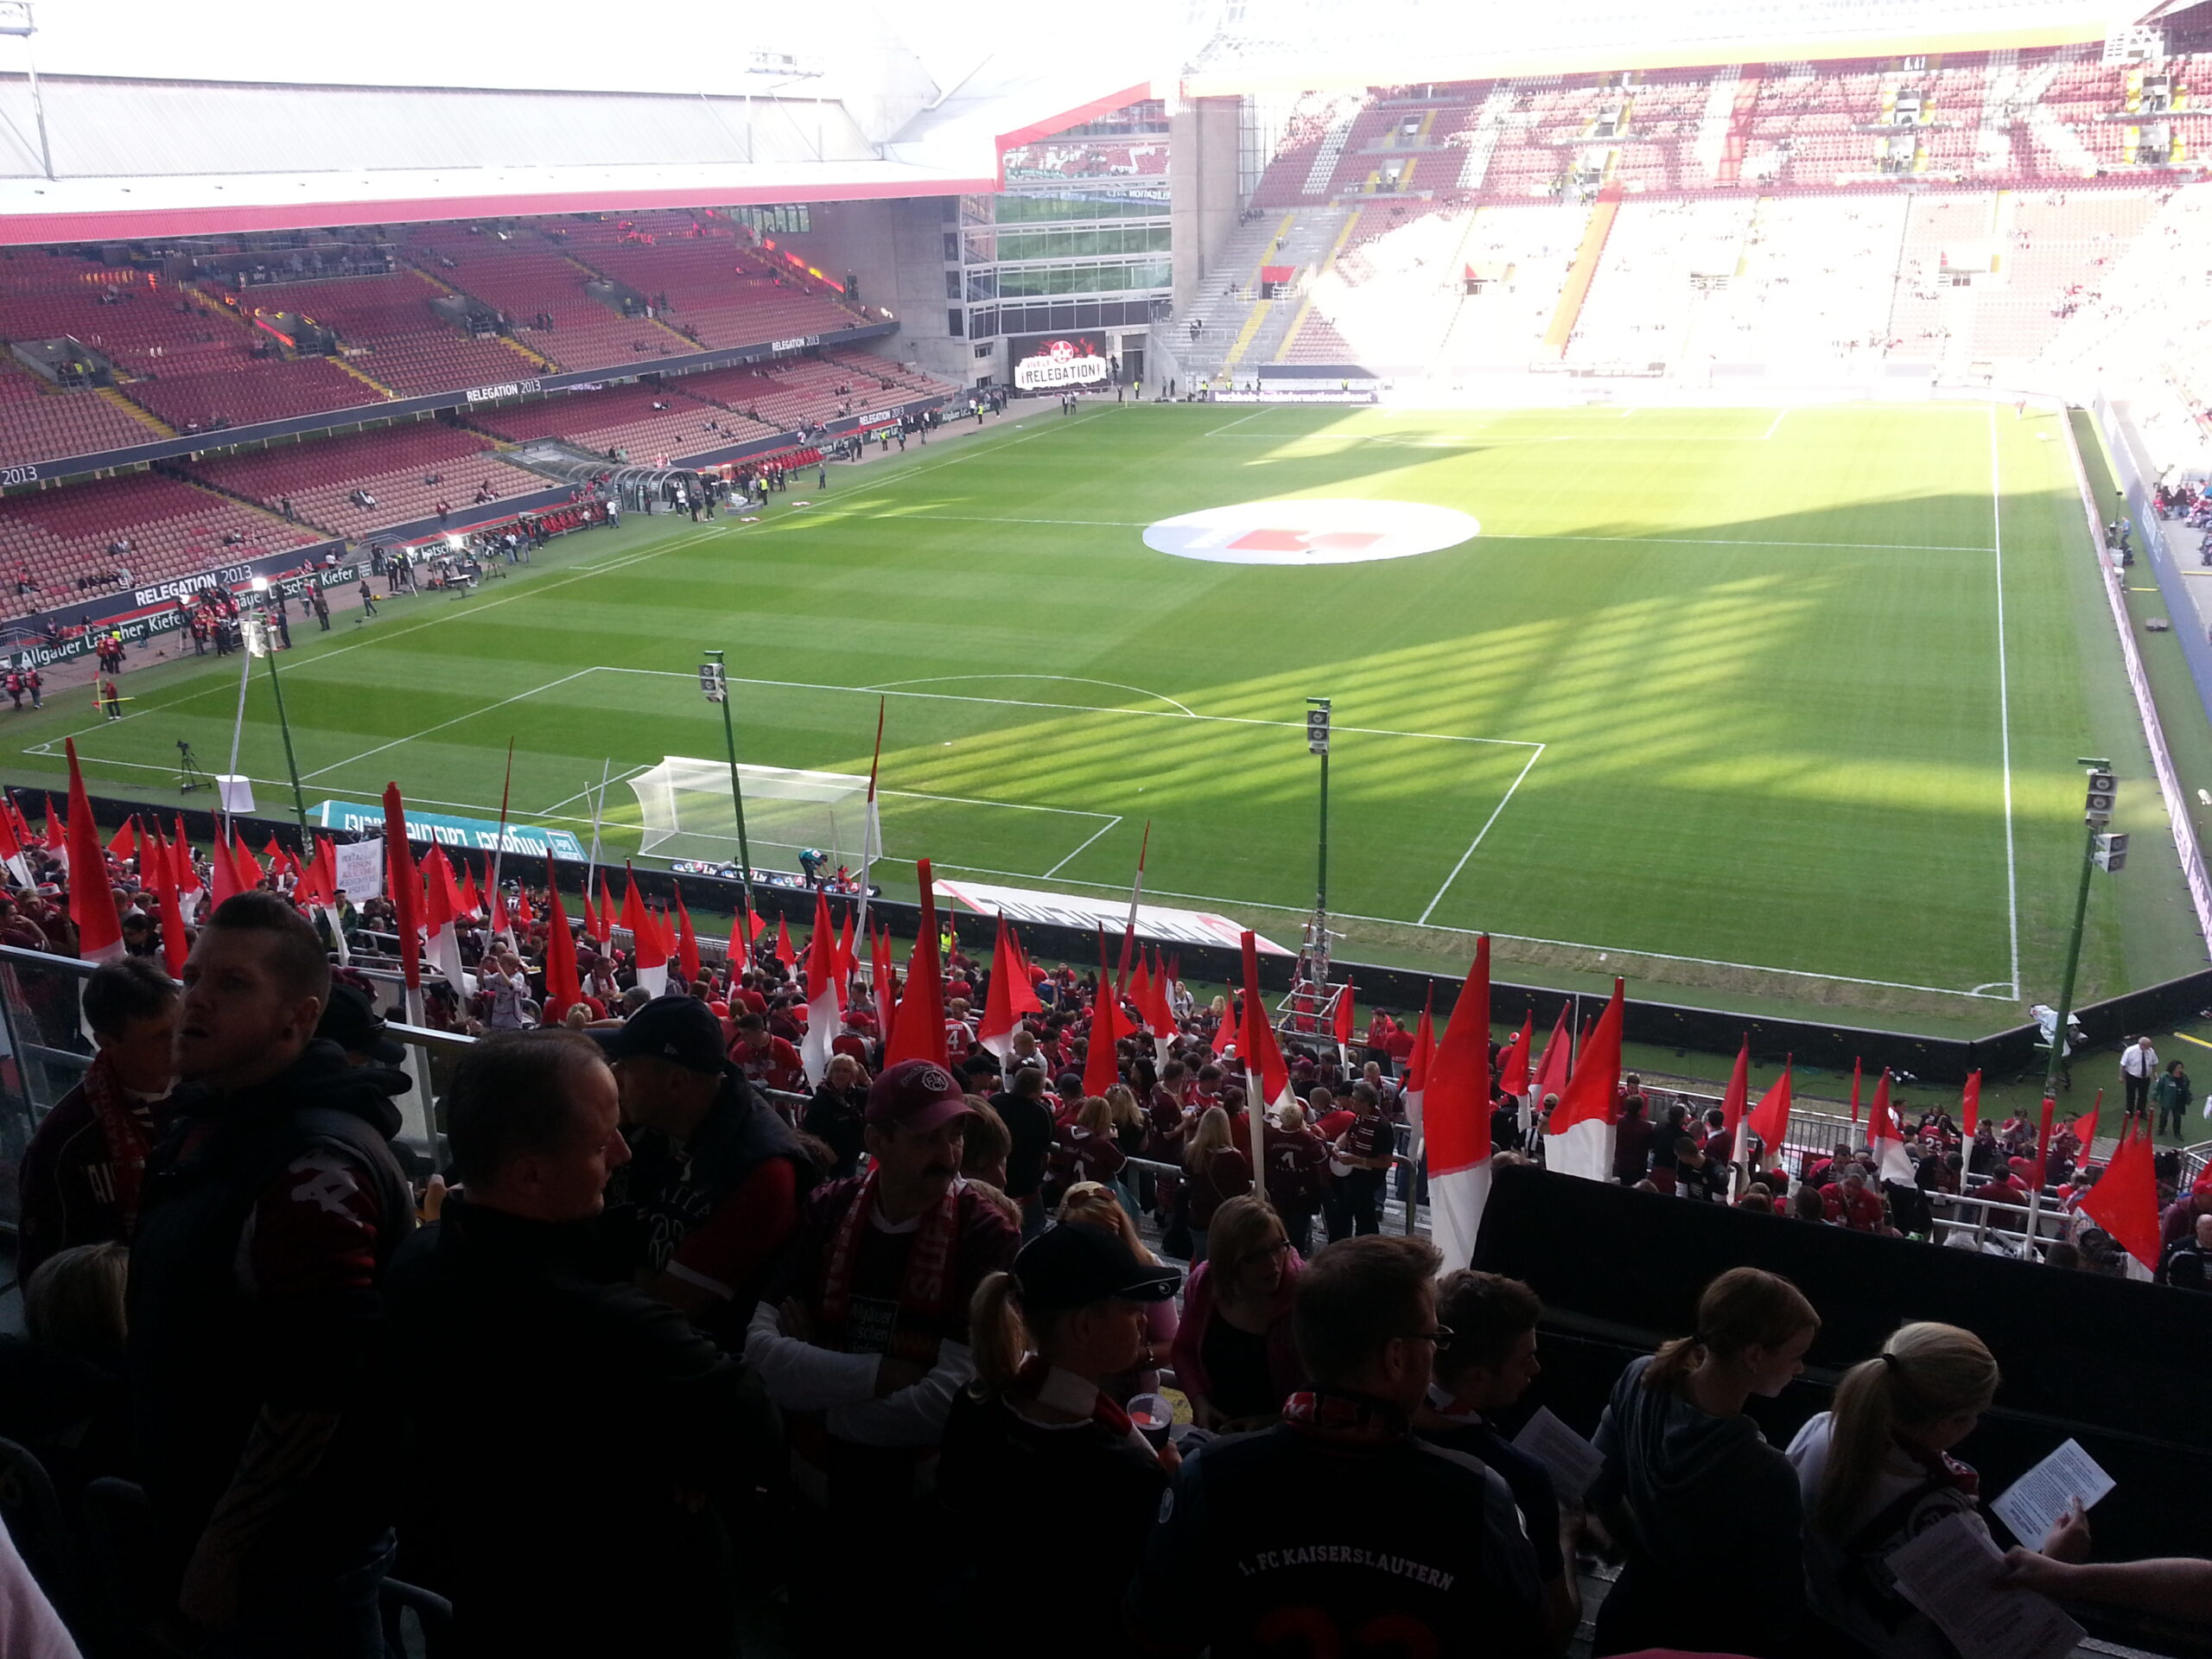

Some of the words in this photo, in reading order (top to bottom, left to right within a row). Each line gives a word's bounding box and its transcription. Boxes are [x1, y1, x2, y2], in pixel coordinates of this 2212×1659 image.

[772, 337, 805, 352] RELEGATION
[467, 384, 518, 403] RELEGATION
[520, 380, 542, 394] 2013
[1, 466, 38, 486] 2013
[135, 572, 217, 607] RELEGATION
[220, 564, 253, 584] 2013
[321, 568, 353, 587] Kiefer
[947, 1030, 959, 1050] 4
[1924, 1136, 1943, 1155] 23
[1255, 1551, 1280, 1572] FC
[1281, 1544, 1455, 1592] KAISERSLAUTERN
